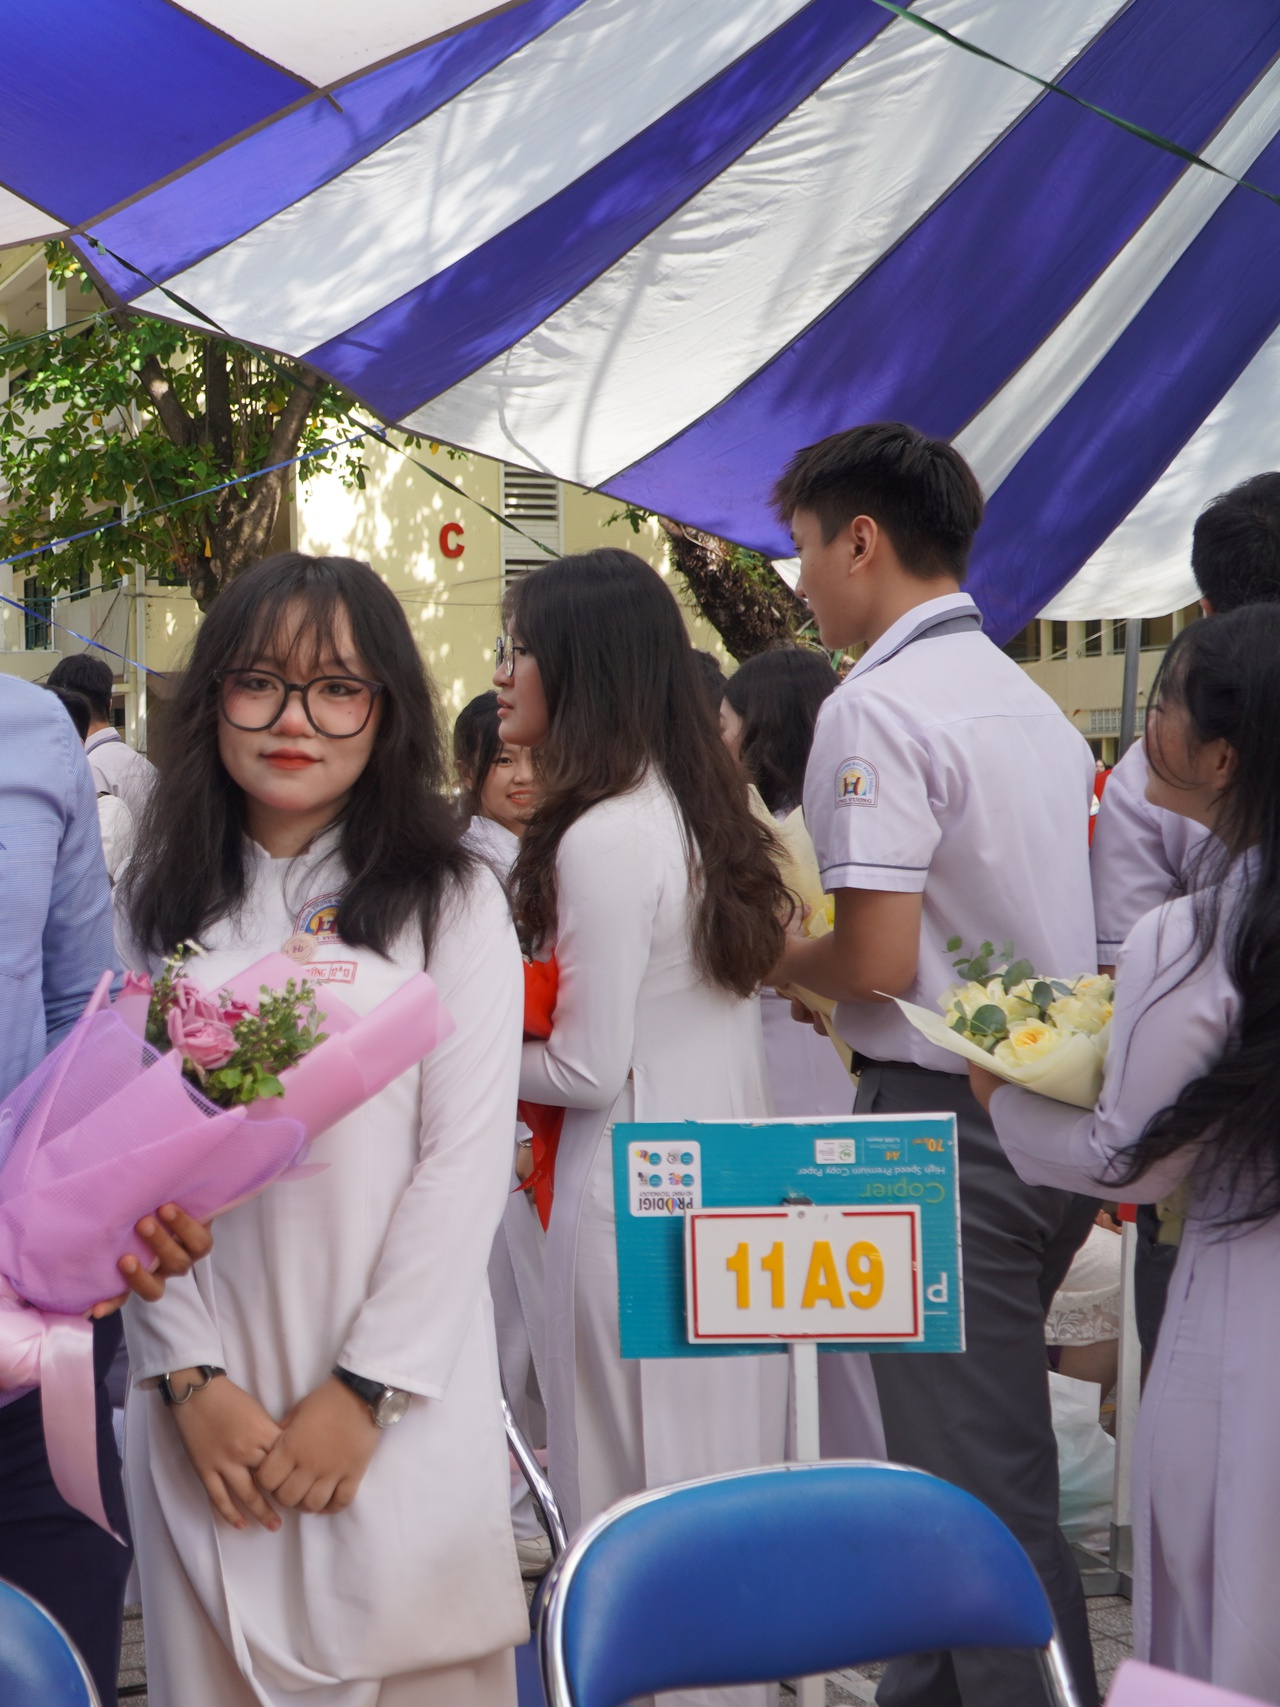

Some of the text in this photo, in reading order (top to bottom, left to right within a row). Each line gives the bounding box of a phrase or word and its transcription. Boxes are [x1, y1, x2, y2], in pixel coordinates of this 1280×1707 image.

[439, 522, 465, 559] C
[885, 1151, 900, 1161] A4
[797, 1164, 946, 1177] High Speed Premium Copy Paper
[859, 1178, 946, 1204] Copier
[726, 1240, 885, 1310] 11A9
